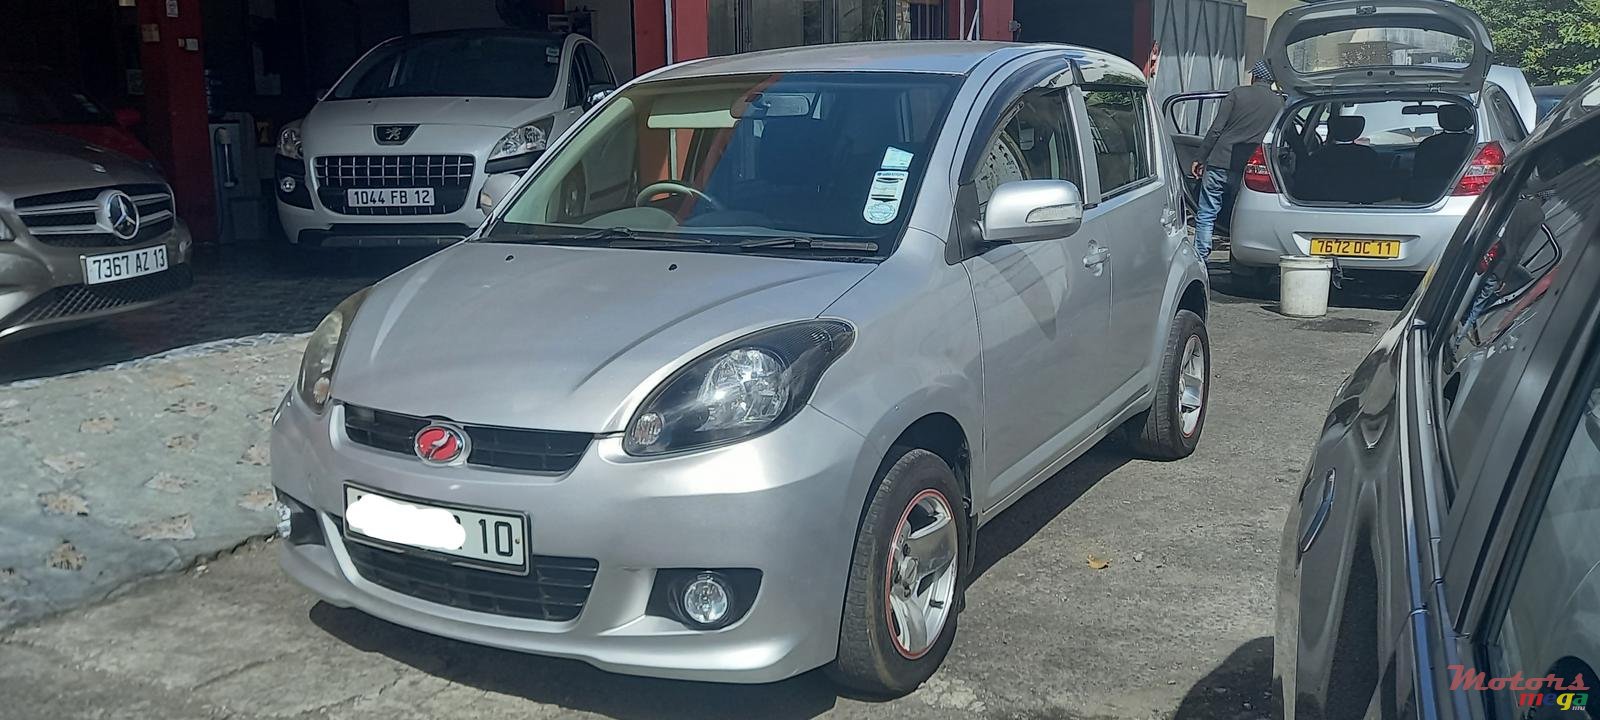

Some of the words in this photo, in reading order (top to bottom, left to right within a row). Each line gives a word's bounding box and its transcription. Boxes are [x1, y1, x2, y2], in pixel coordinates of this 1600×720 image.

[354, 190, 386, 205] 1044
[391, 190, 408, 204] FB
[414, 189, 430, 204] 12
[1317, 240, 1350, 254] 7672
[1354, 240, 1371, 254] DC
[1377, 242, 1392, 255] 11
[93, 255, 130, 280] 7367
[135, 251, 150, 273] AZ
[153, 248, 165, 268] 13
[478, 518, 514, 557] 10
